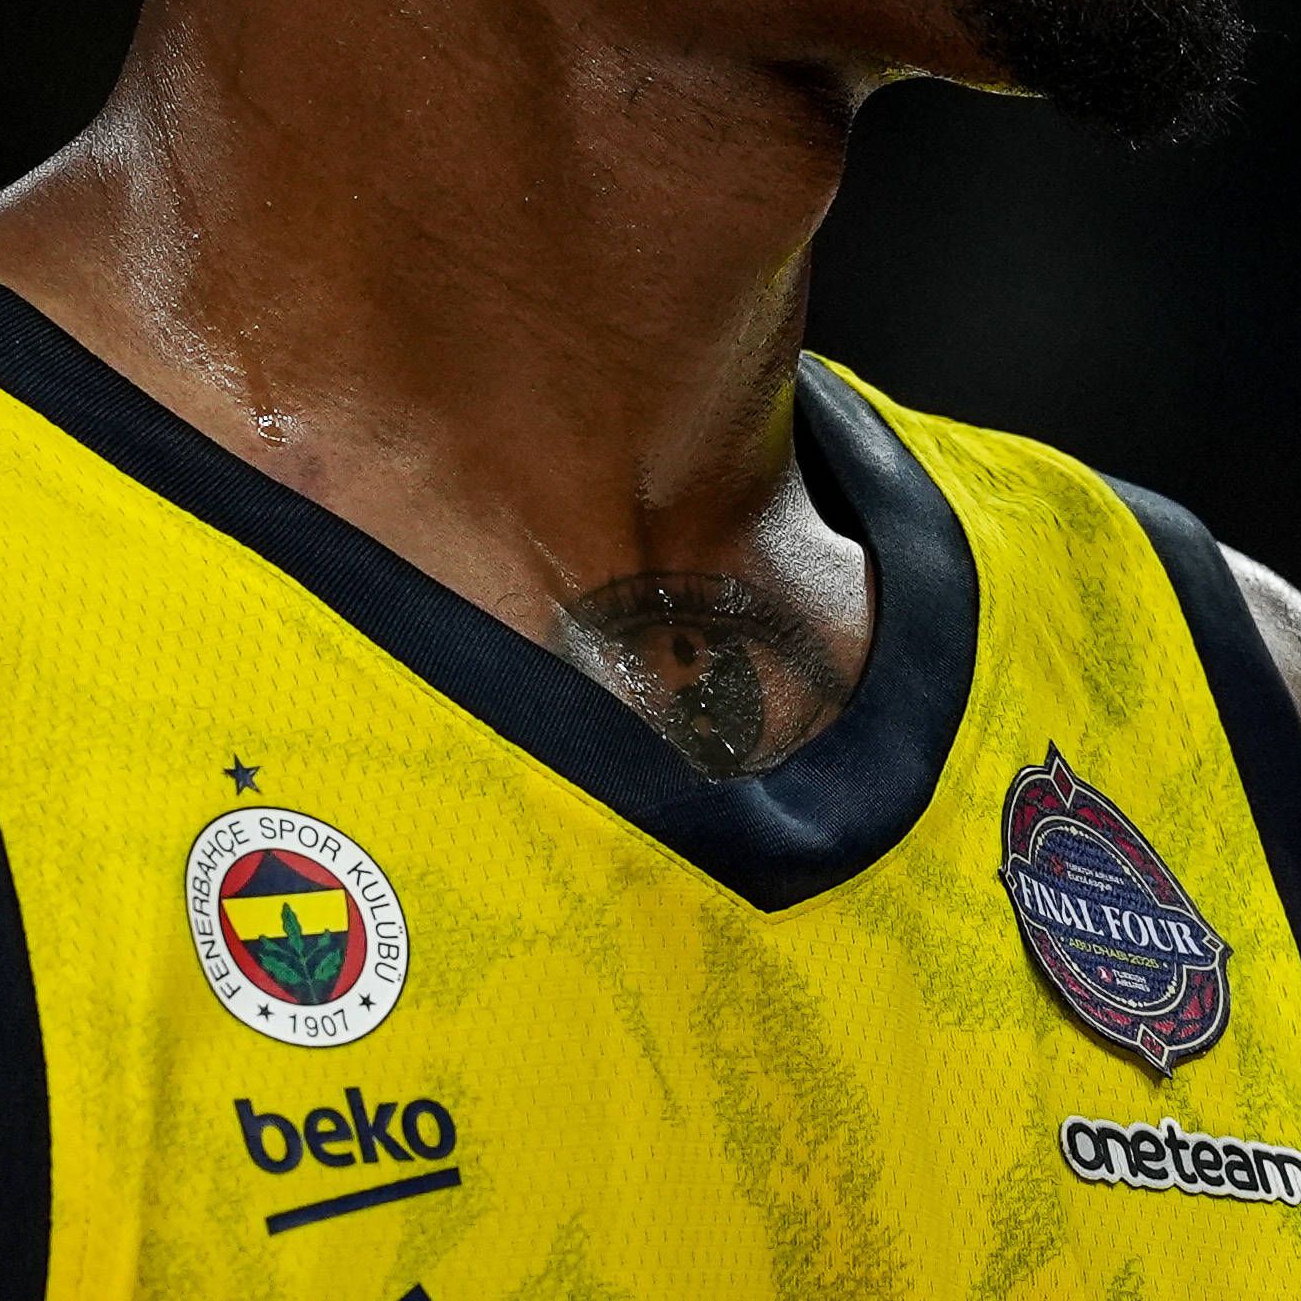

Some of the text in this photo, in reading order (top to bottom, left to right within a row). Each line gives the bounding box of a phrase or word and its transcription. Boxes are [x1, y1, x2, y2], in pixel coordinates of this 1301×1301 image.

[192, 817, 403, 999] FENERBAHÇE SPOR KULÜBÜ
[1018, 871, 1204, 956] FINAL FOUR
[289, 1009, 349, 1038] 1907
[234, 1087, 457, 1174] beko
